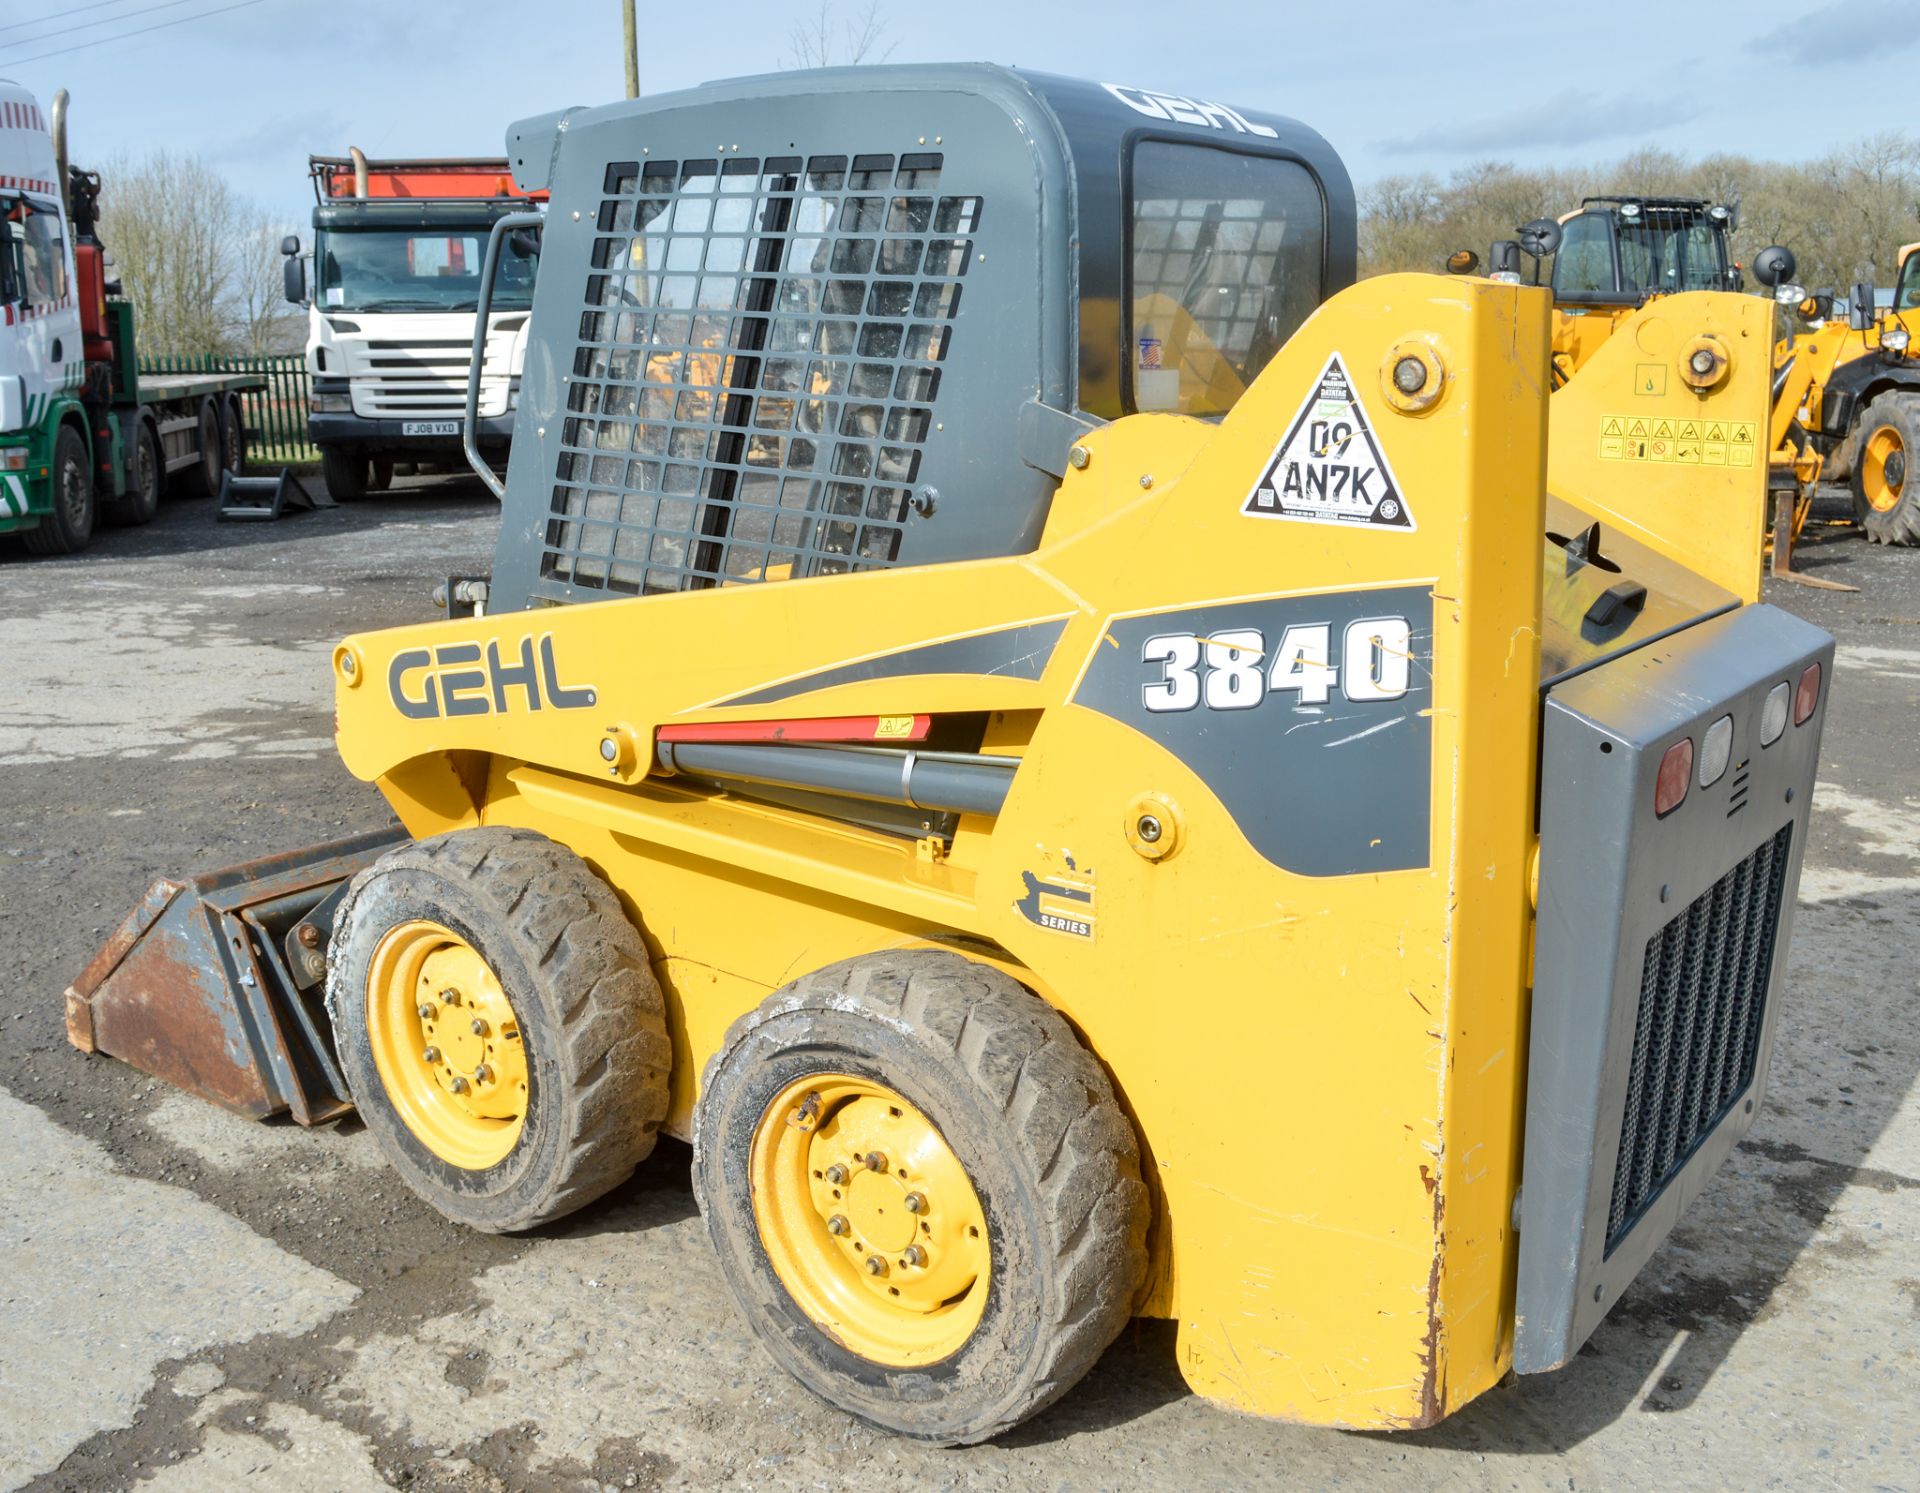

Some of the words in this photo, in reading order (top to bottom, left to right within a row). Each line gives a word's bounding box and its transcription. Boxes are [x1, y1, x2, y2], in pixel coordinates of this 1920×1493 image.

[1100, 82, 1280, 138] GEHL
[406, 423, 433, 434] FJ08
[435, 423, 455, 433] VXD
[1282, 461, 1375, 506] AN7K
[388, 632, 597, 720] GEHL
[1142, 615, 1413, 713] 3840
[1040, 914, 1088, 935] SERIES
